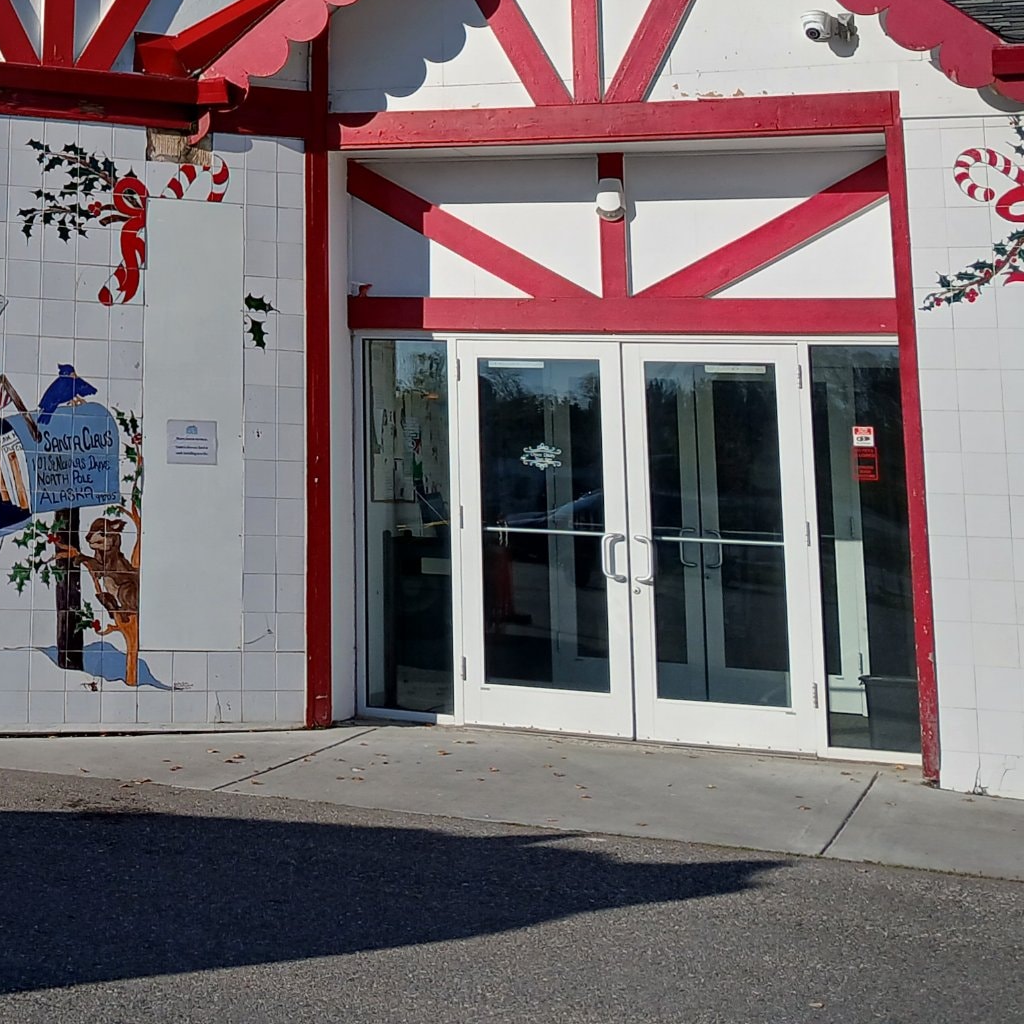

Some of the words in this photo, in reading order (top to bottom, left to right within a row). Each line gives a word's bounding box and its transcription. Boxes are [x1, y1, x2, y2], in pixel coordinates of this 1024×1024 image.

[43, 430, 85, 452] SANTA
[82, 426, 113, 450] CLAUS
[37, 473, 70, 486] NORTH
[72, 469, 94, 485] POLE
[39, 487, 94, 505] ALASKA
